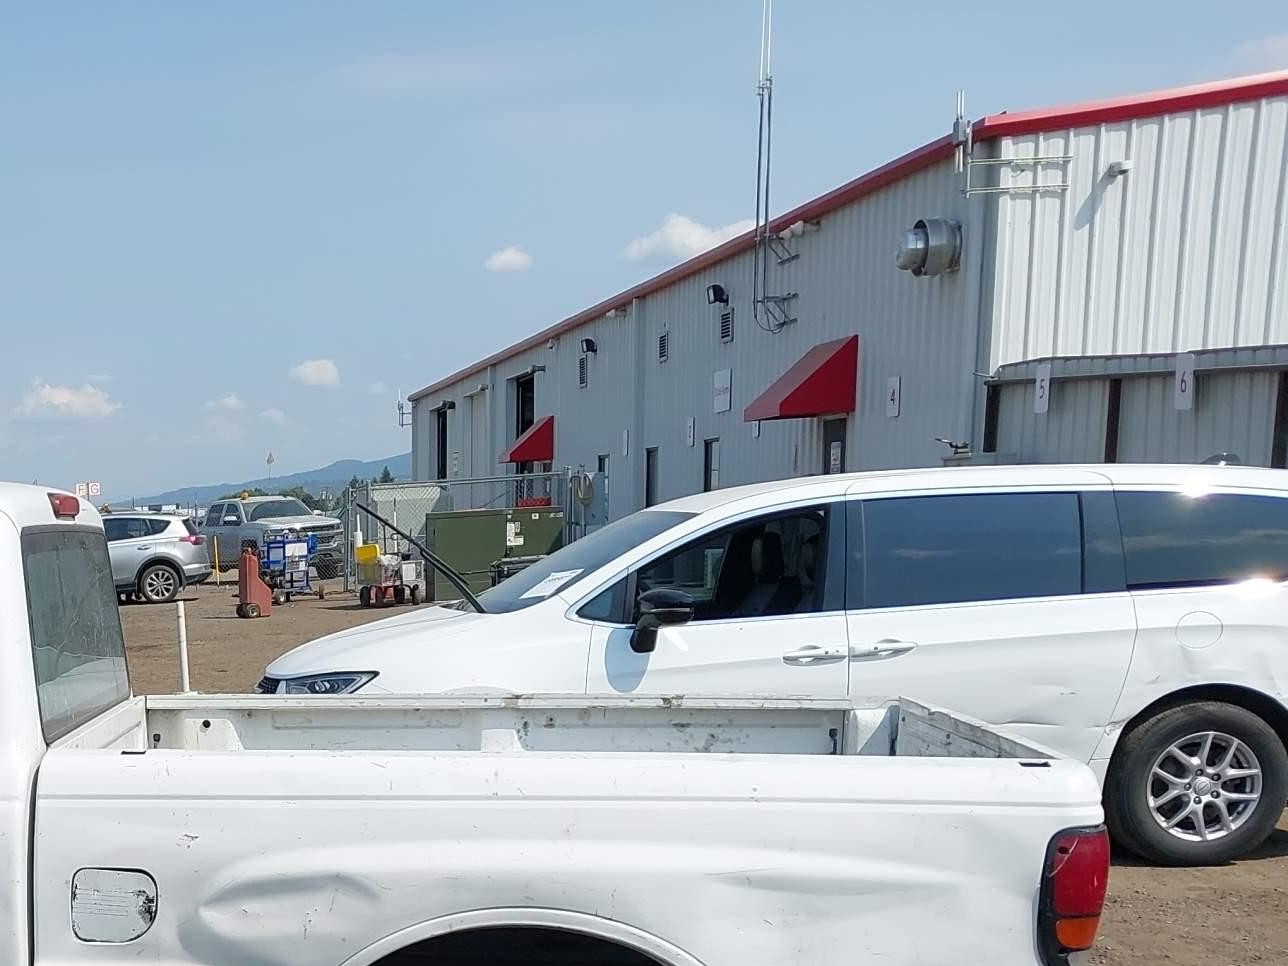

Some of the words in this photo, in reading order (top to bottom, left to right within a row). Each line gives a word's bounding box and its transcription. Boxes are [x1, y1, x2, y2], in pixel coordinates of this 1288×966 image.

[1039, 378, 1045, 399] 5
[1180, 370, 1187, 393] 6
[890, 388, 896, 405] 4
